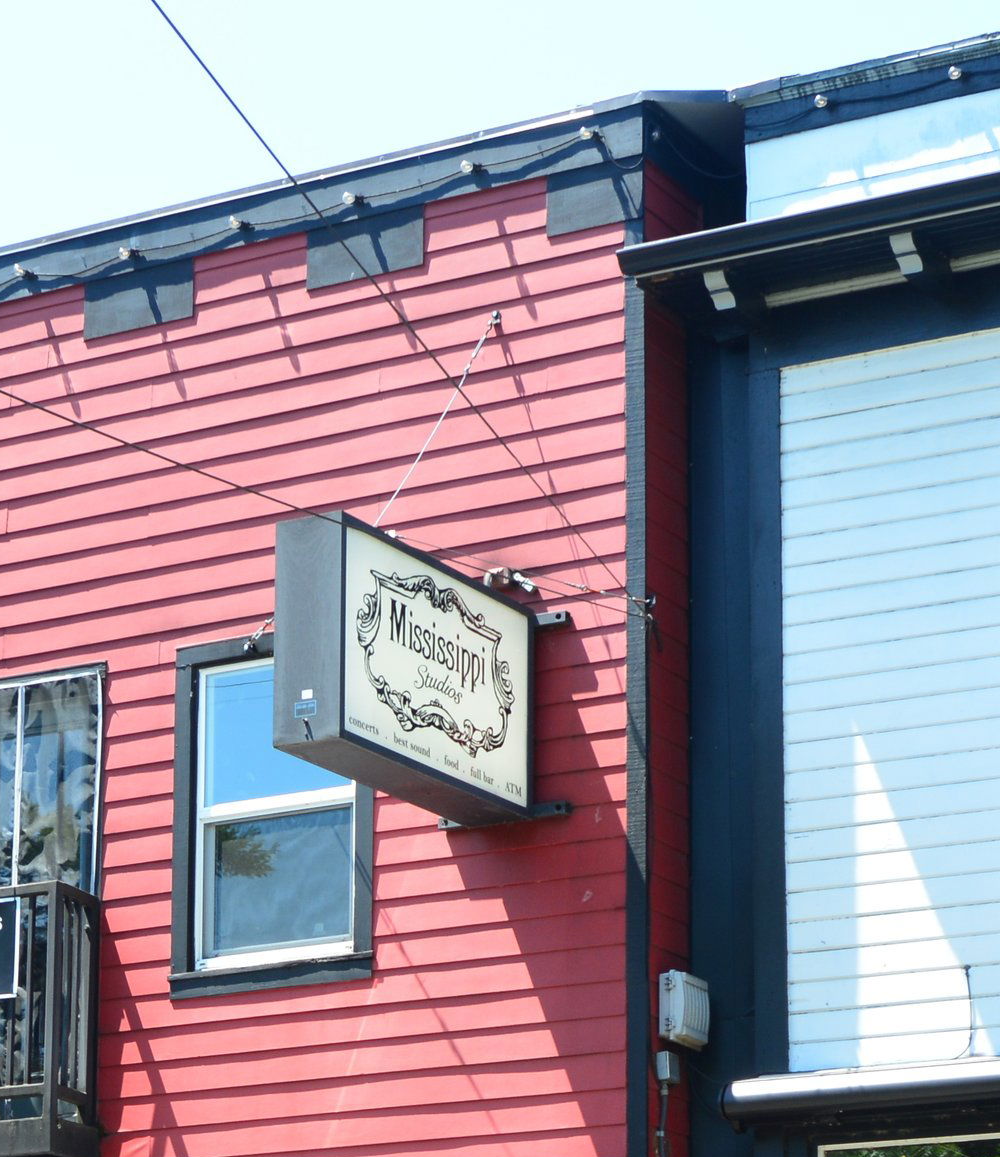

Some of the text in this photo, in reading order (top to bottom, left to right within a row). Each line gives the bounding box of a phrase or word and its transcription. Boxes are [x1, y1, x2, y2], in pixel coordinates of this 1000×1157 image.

[390, 597, 485, 693] Mississippi
[414, 664, 463, 705] Studios
[348, 716, 522, 797] concerts best sound food full bar ATM
